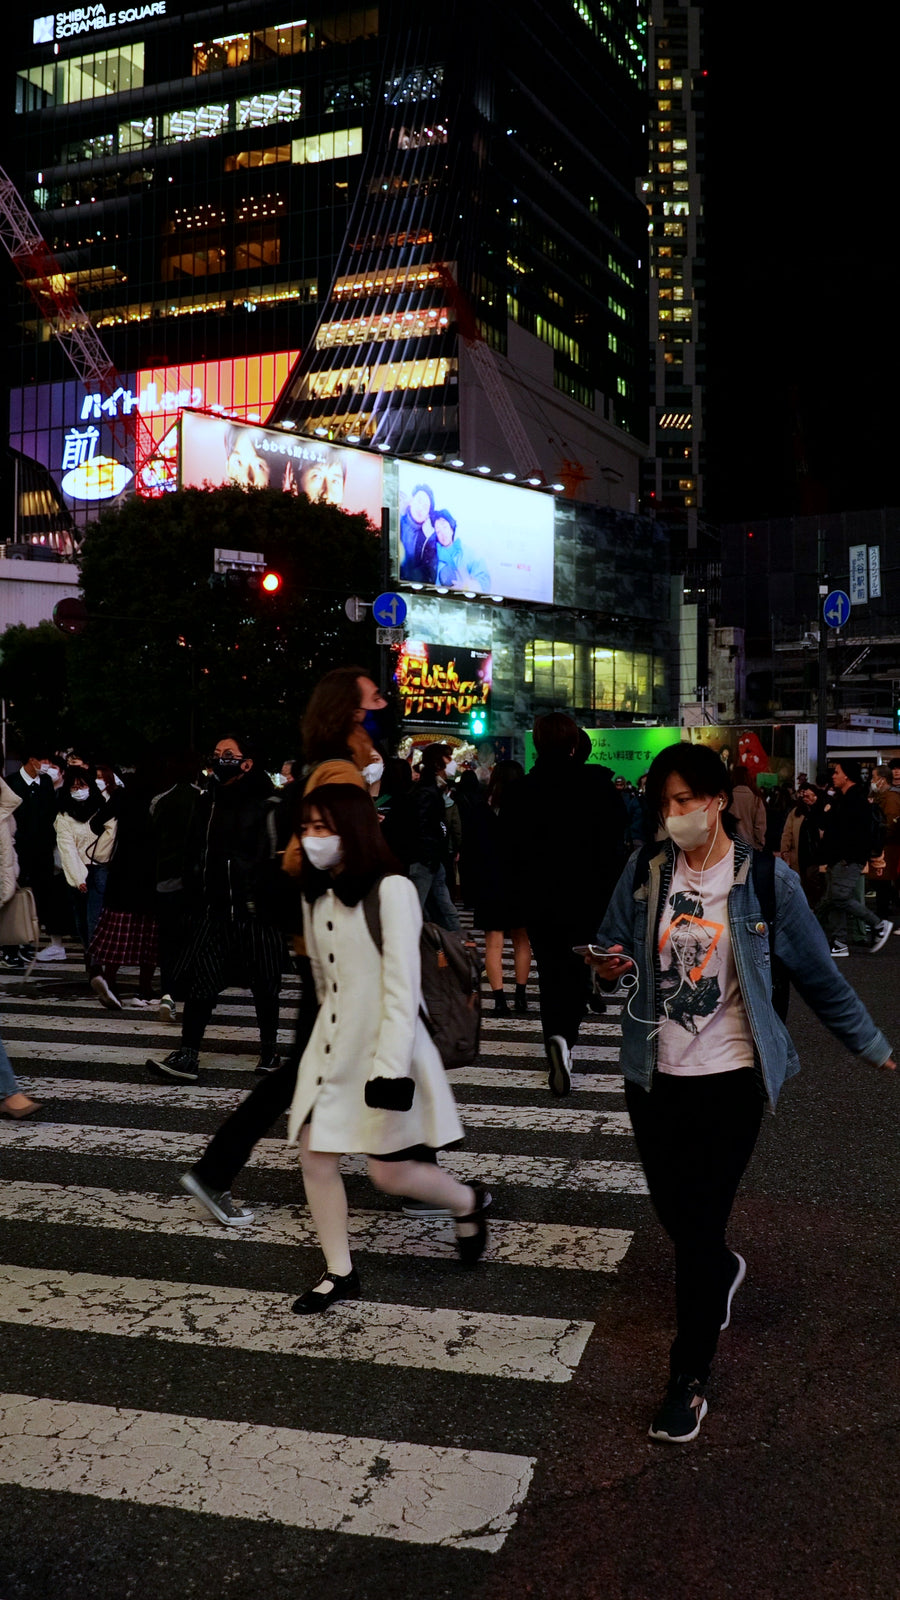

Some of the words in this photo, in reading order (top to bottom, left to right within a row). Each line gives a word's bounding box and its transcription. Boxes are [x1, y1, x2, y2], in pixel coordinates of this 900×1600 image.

[56, 3, 106, 26] SHIBUYA
[56, 13, 117, 38] SCRAMBLE
[118, 1, 166, 24] SQUARE
